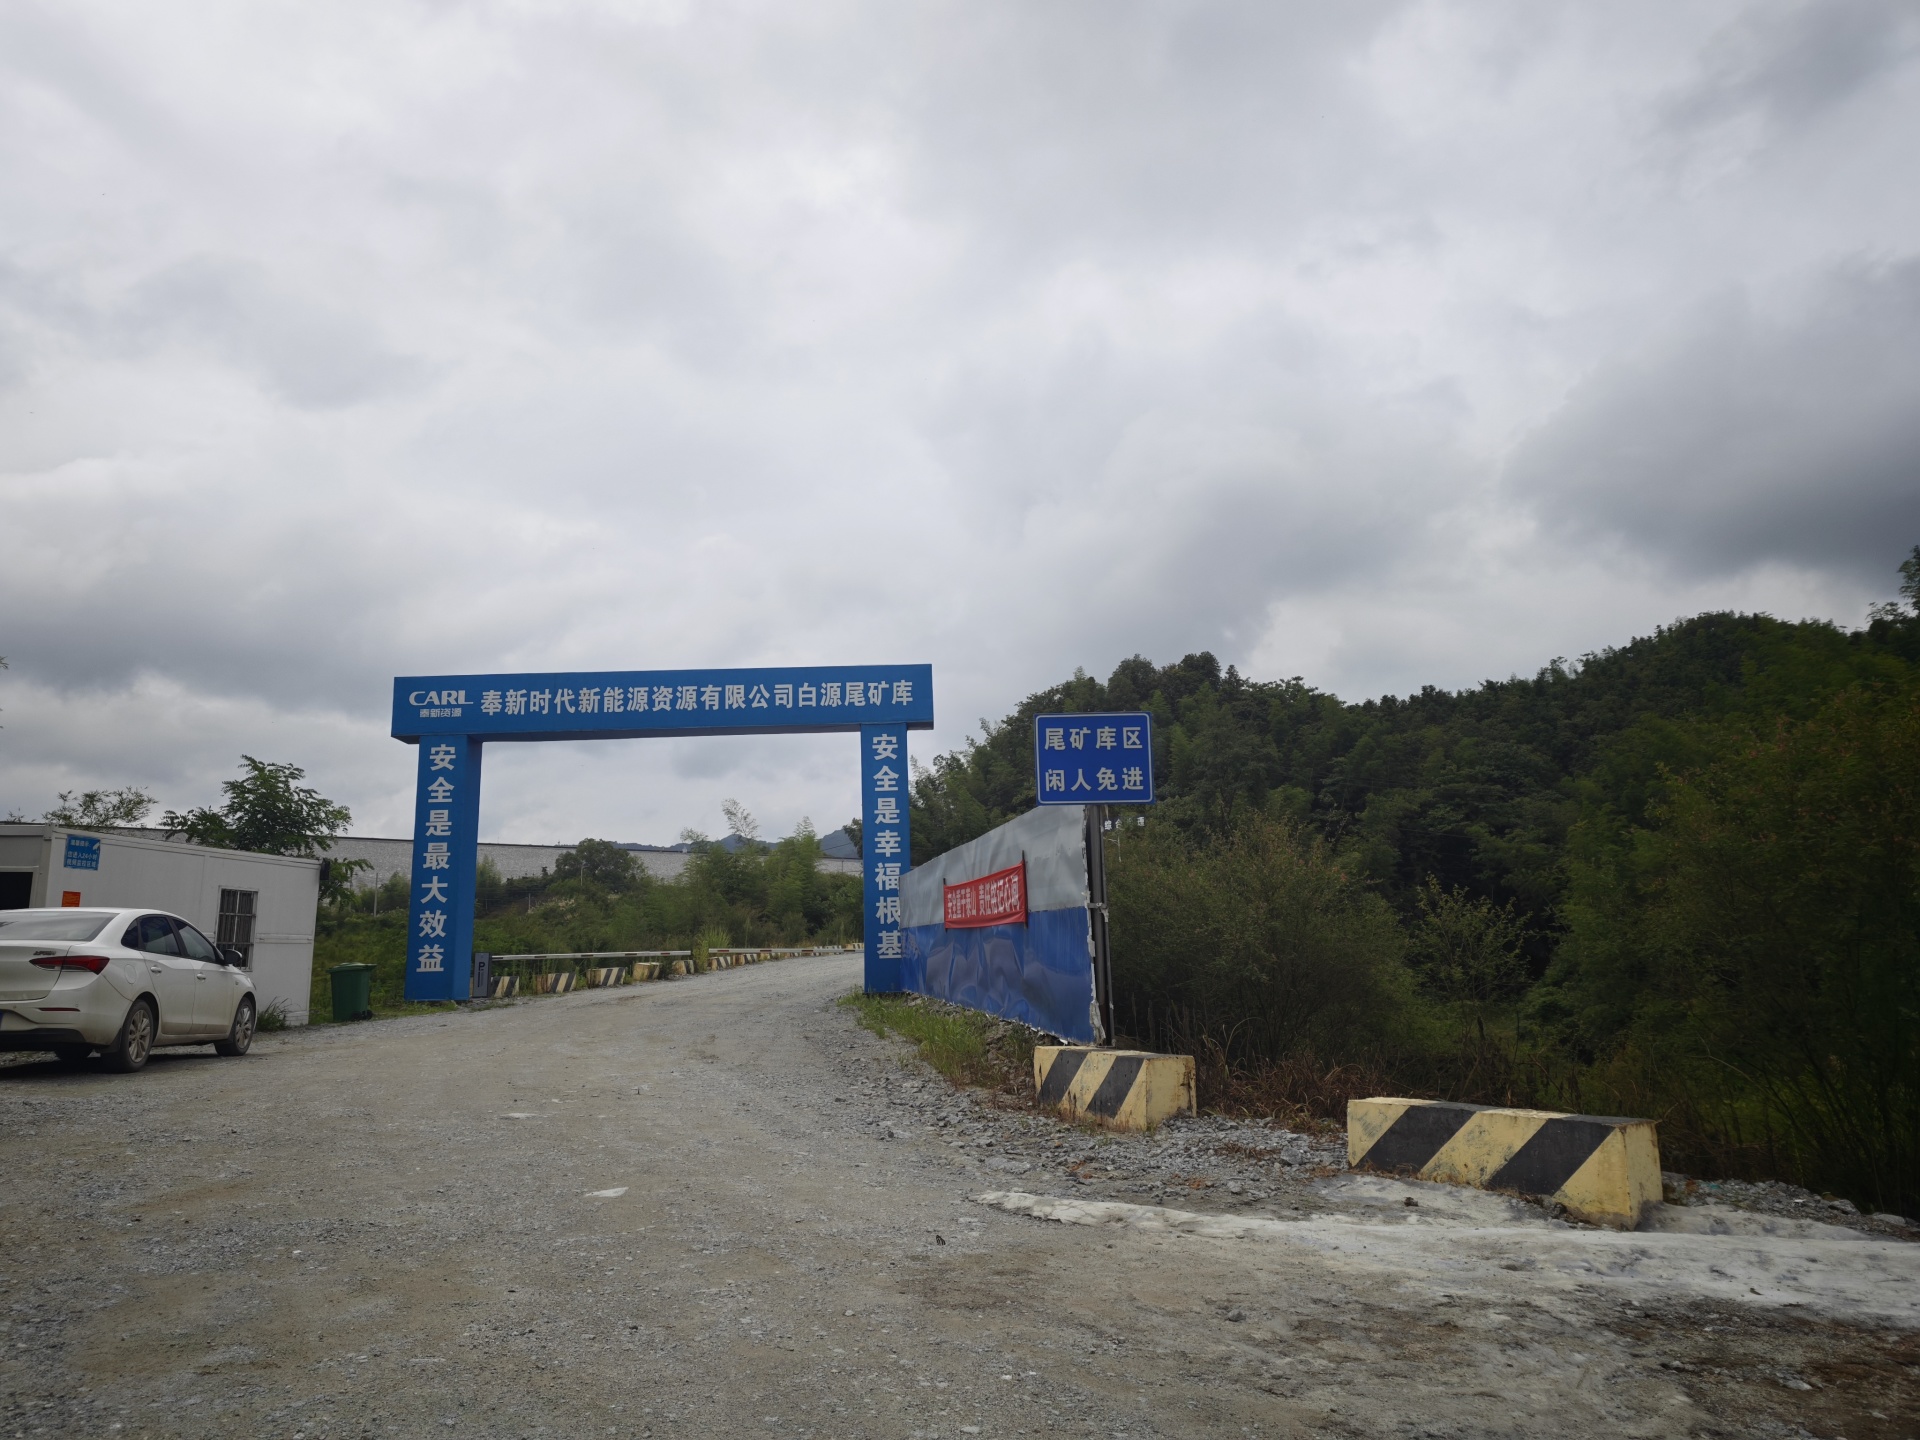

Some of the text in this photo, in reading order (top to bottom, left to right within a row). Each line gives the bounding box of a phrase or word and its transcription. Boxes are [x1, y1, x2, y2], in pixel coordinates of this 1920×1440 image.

[409, 690, 474, 706] CARL
[480, 680, 914, 716] 奉新时代新能源资源有限公司白源尾矿库
[1044, 726, 1143, 751] 尾矿库区
[1045, 767, 1144, 792] 闲人免进
[416, 744, 456, 972] 安全是最大效益
[872, 734, 902, 959] 安全是幸福根基
